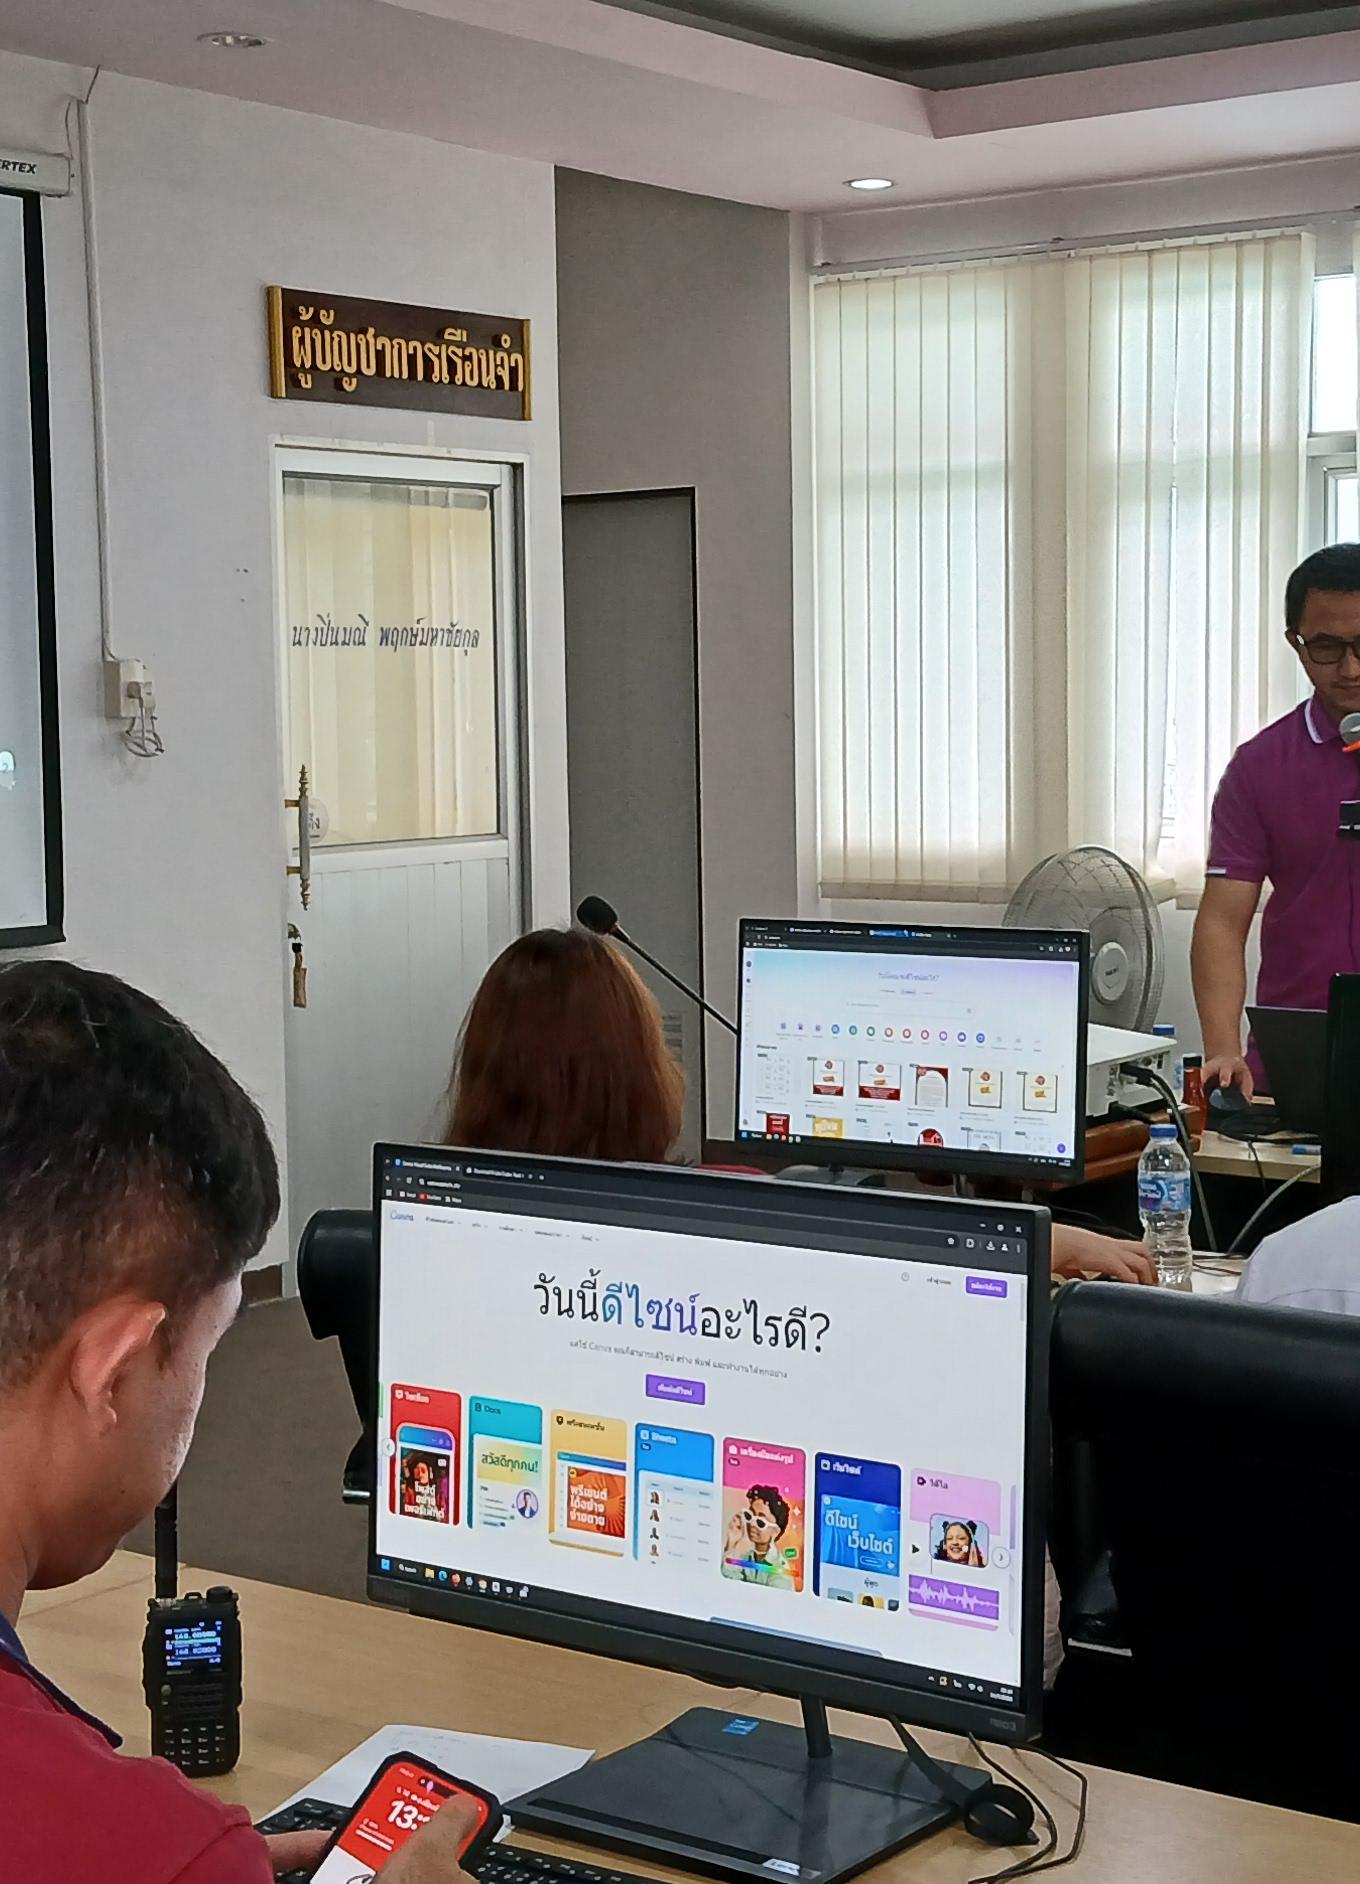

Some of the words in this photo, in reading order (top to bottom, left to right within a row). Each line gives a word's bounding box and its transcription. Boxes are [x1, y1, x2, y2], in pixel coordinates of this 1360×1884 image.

[292, 305, 524, 393] ผู้บัญชาการเรือนจำ
[533, 1268, 831, 1353] วันนี้ดีไซน์อะไรดี?
